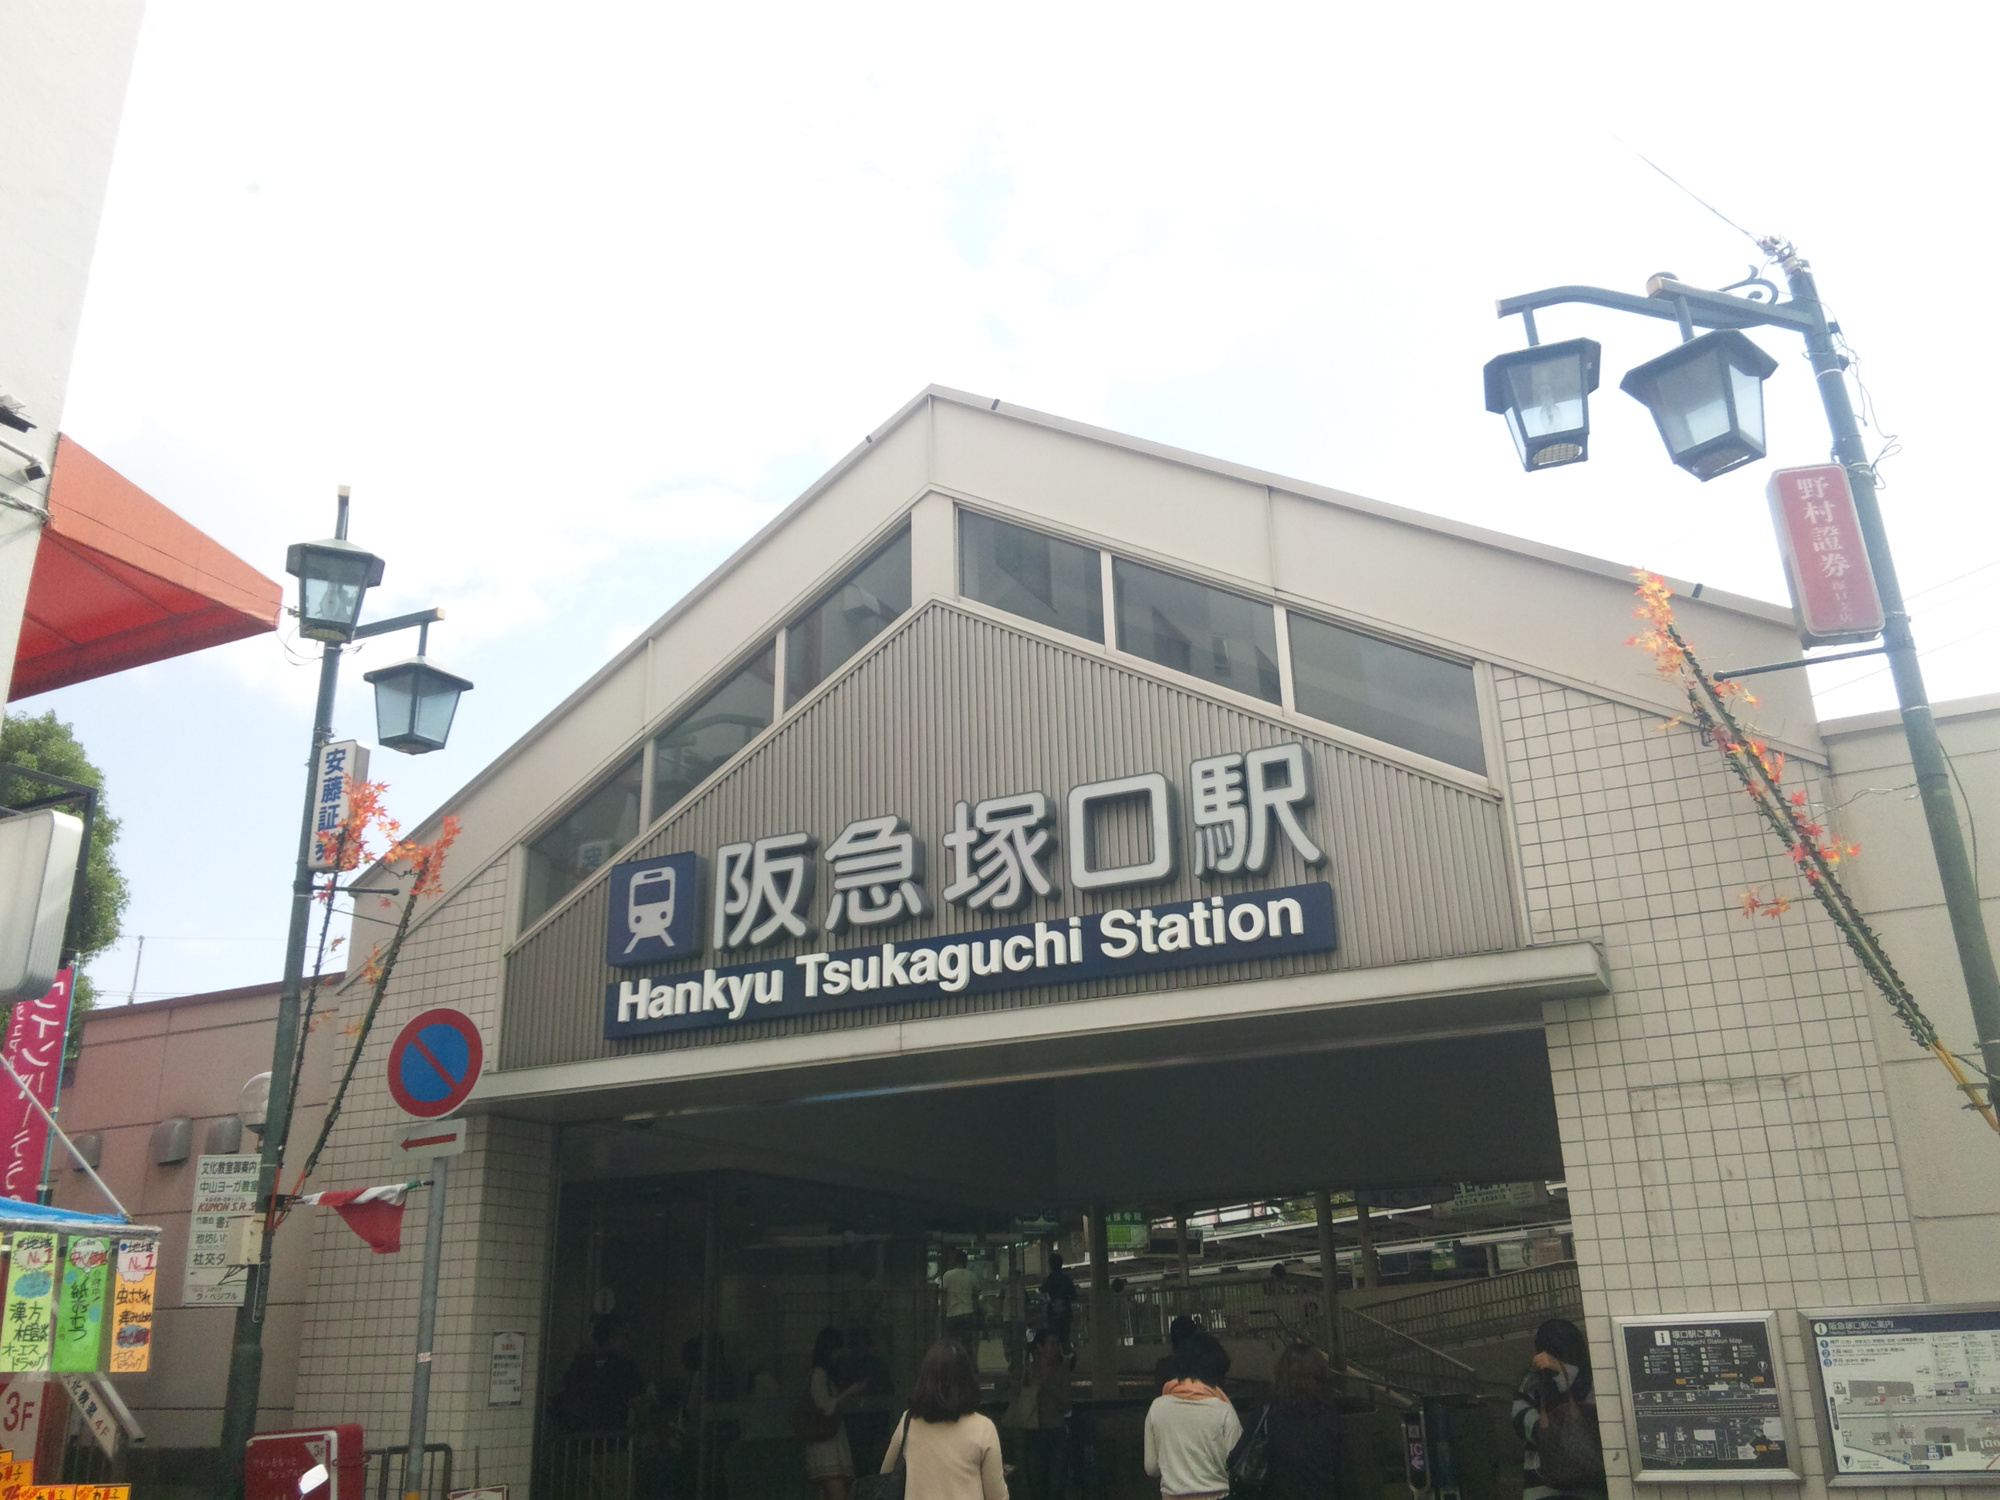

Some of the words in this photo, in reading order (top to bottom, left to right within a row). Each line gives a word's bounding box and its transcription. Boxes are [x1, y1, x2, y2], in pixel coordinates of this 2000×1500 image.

[1796, 476, 1851, 578] 野村證券
[714, 741, 1328, 953] 阪急塚口駅
[617, 969, 784, 1023] Hankyu
[796, 921, 1083, 998] Tsukaguchi
[1101, 896, 1304, 959] Station
[201, 1161, 257, 1175] 文化教室御案内
[197, 1202, 230, 1212] KUMON
[116, 1287, 151, 1306] 虫さされ
[10, 1301, 43, 1324] 漢方
[13, 1322, 50, 1342] 相談
[1673, 1339, 1705, 1347] Tsukaguchi
[1729, 1337, 1743, 1345] Map
[3, 1391, 35, 1432] 3F
[313, 1444, 325, 1457] 3F
[1409, 1443, 1423, 1455] IC
